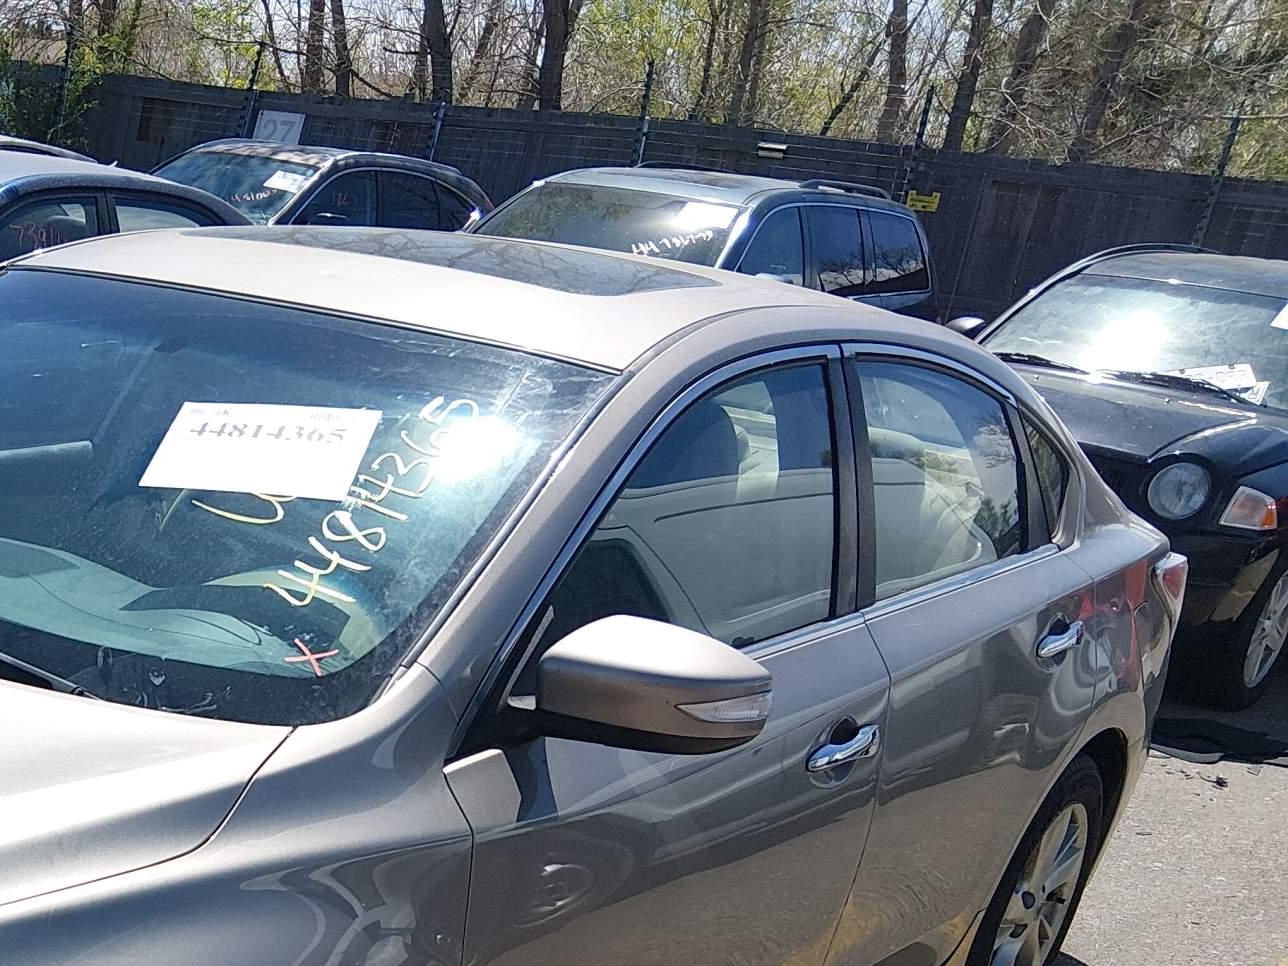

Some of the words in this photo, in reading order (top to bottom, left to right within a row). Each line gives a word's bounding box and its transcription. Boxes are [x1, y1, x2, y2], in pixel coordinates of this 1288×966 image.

[262, 118, 298, 143] 27
[190, 422, 348, 444] 44814365
[263, 395, 480, 608] 44814365
